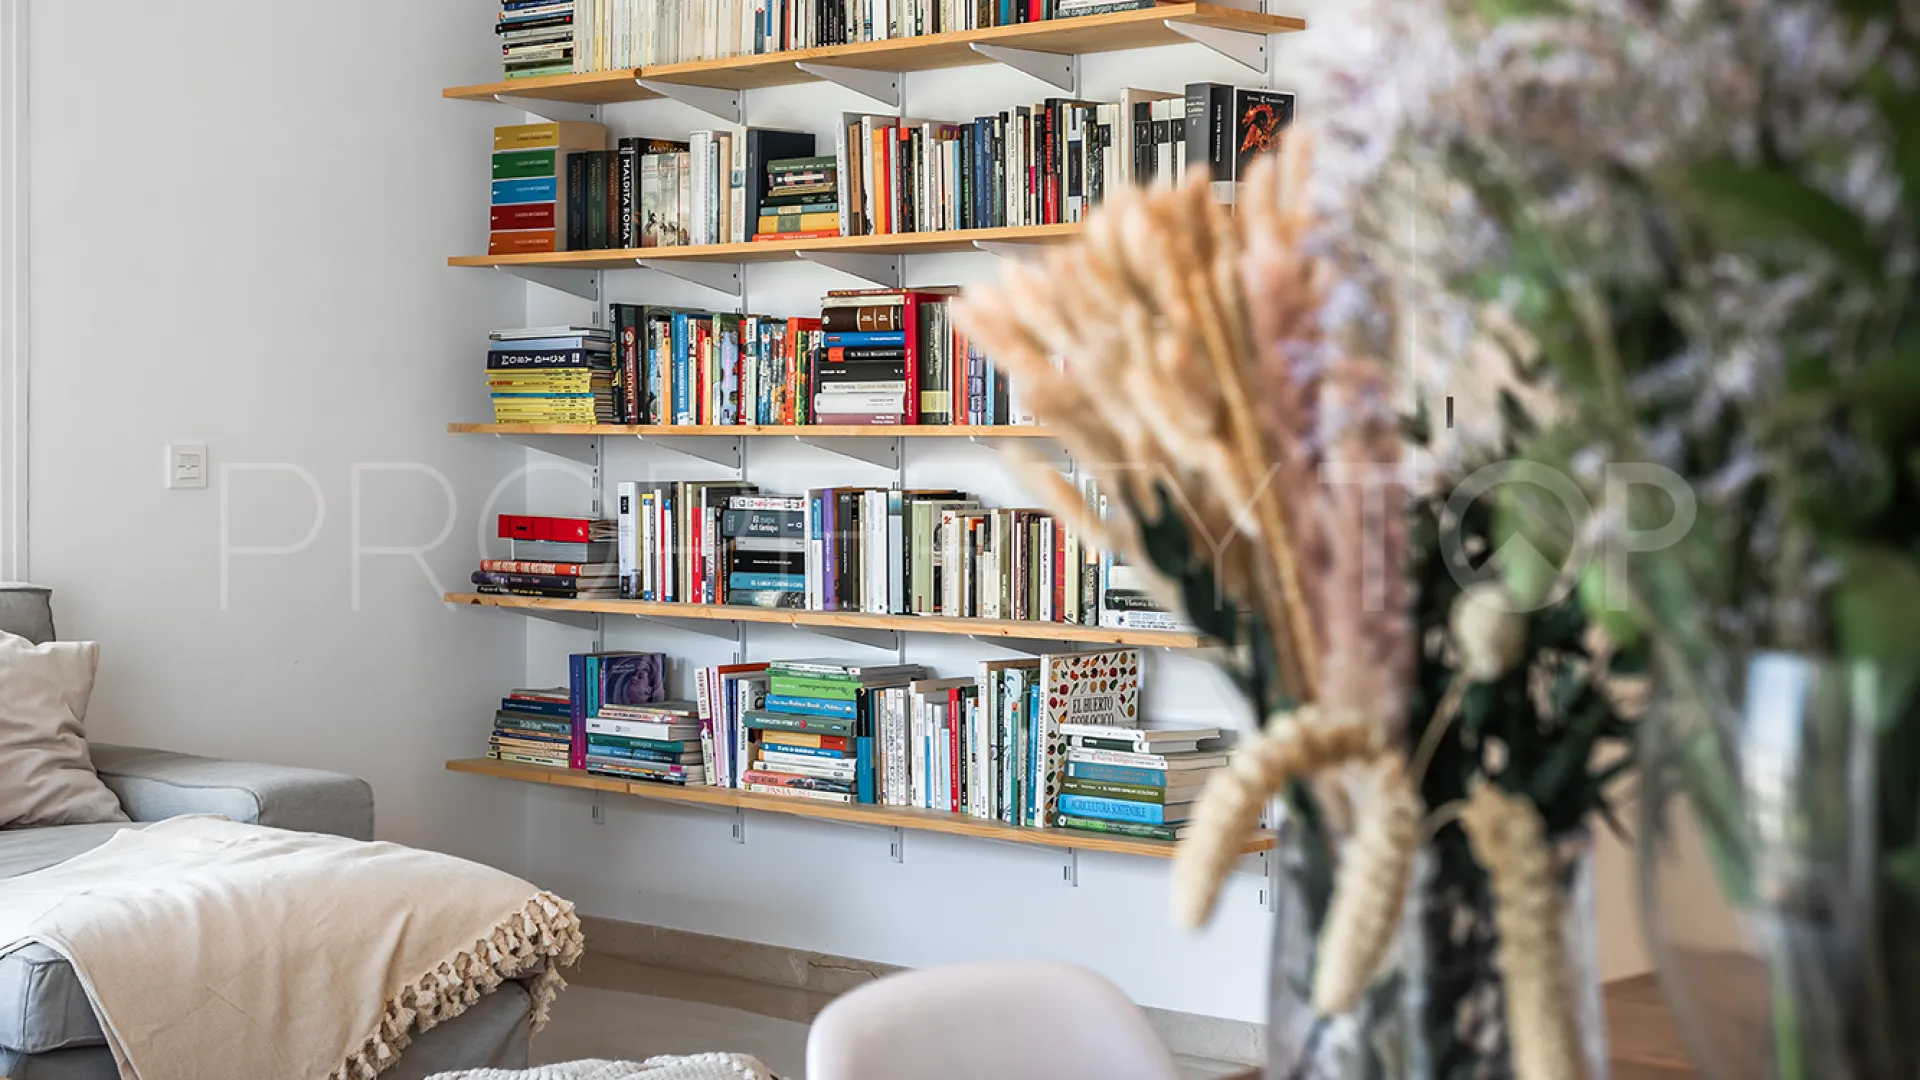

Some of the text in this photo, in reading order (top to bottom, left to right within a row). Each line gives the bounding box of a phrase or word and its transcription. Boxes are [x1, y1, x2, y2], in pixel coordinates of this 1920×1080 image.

[501, 354, 567, 365] MOBY DICK
[1073, 696, 1114, 714] EL HUERTO
[1071, 799, 1147, 819] AGRICULTURA SOSTENIBLE
